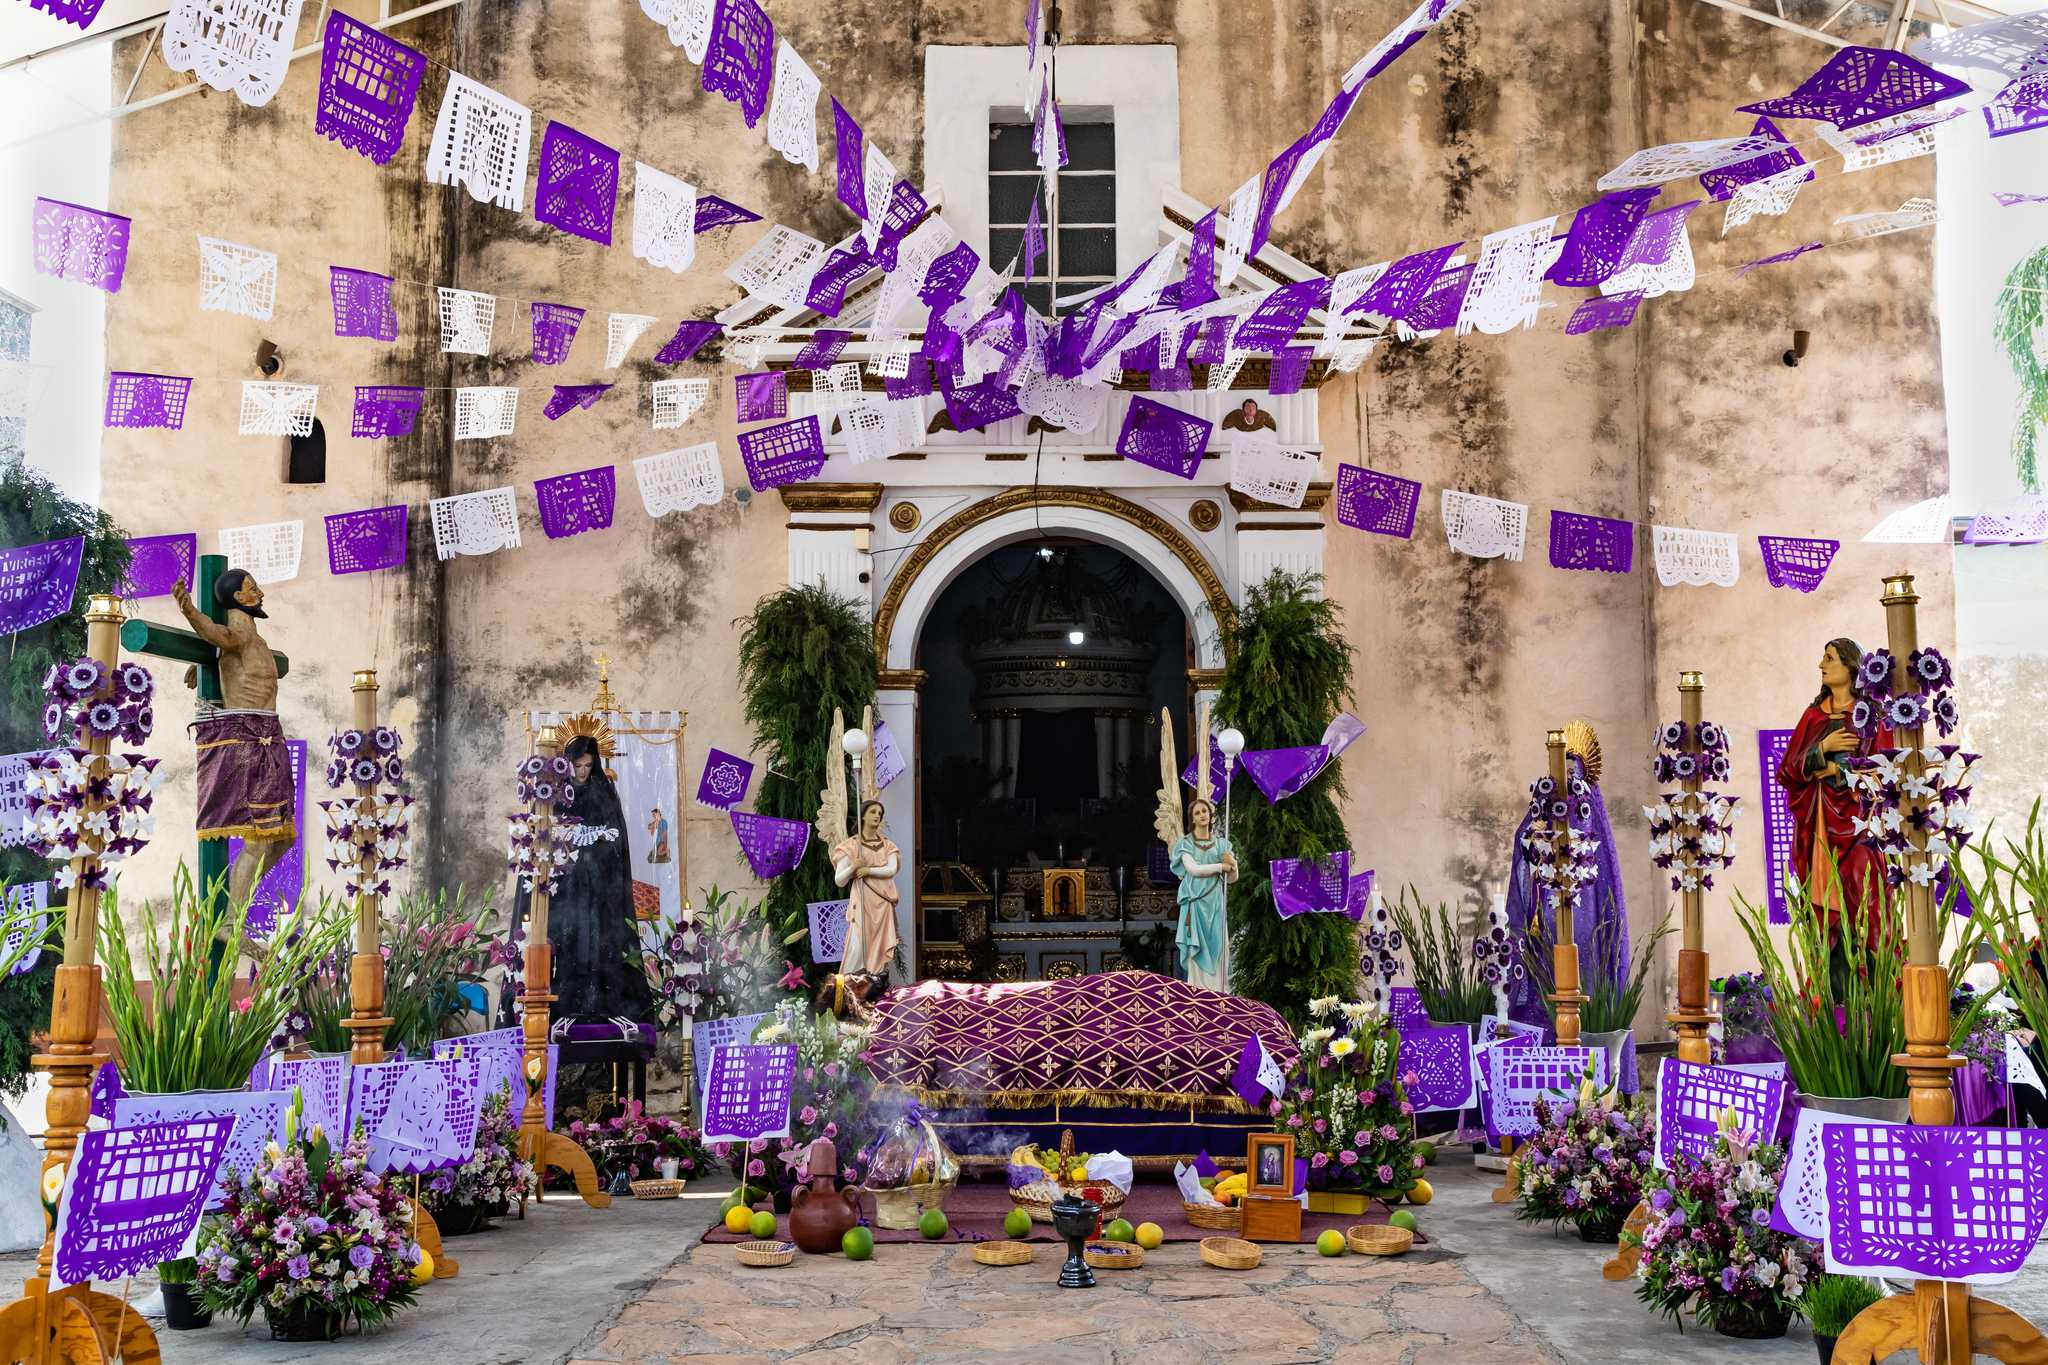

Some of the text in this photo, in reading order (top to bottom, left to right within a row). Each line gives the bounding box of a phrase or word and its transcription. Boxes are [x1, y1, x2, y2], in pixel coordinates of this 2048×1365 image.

[361, 33, 395, 57] SANTO
[762, 425, 792, 438] SANTO
[1784, 539, 1813, 549] SANTO
[7, 554, 50, 572] VIRGEN
[0, 579, 57, 604] OLORES
[1521, 1047, 1566, 1057] SANTO
[1698, 1067, 1742, 1084] SANTO
[131, 1125, 188, 1145] SANTO
[100, 1219, 180, 1251] ENTIERRO
